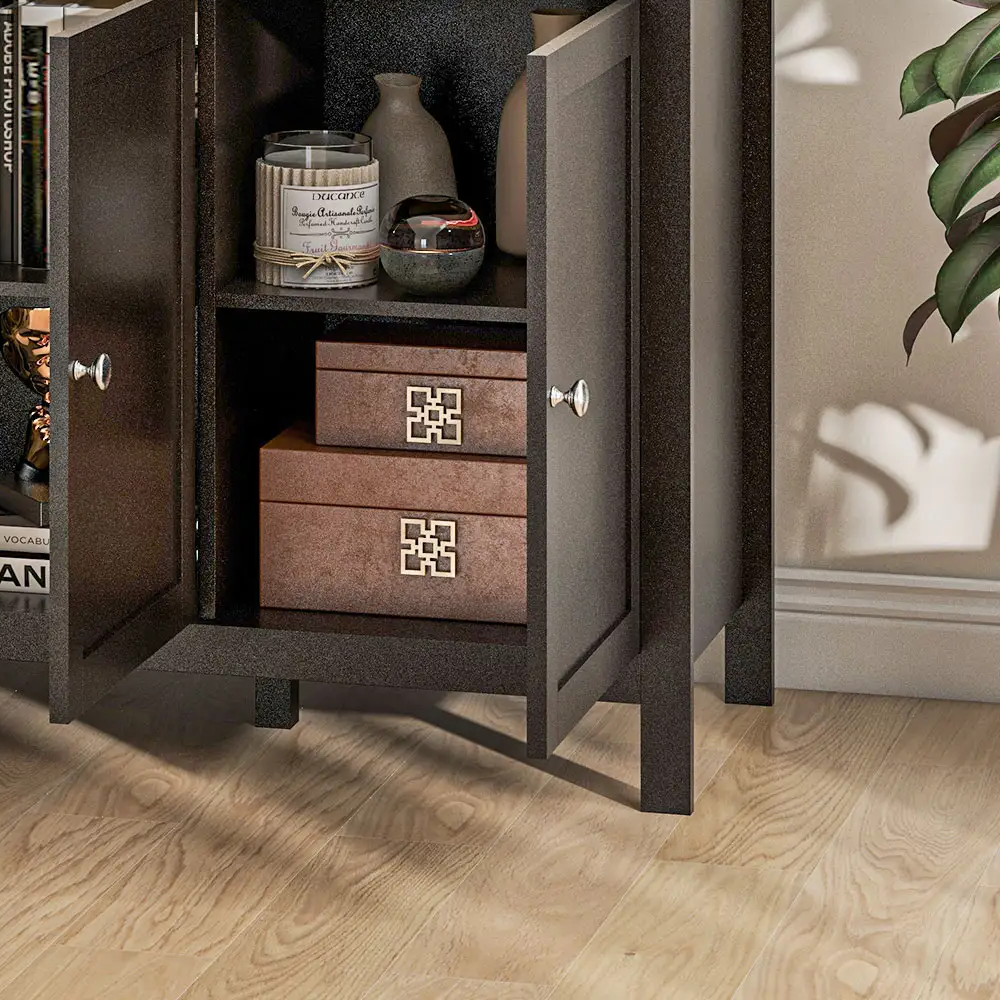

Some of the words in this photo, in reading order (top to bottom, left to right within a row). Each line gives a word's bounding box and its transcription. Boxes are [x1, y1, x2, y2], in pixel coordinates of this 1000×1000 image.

[292, 206, 316, 221] Bougie
[317, 207, 355, 217] Artisanale
[3, 535, 49, 546] VOCABU
